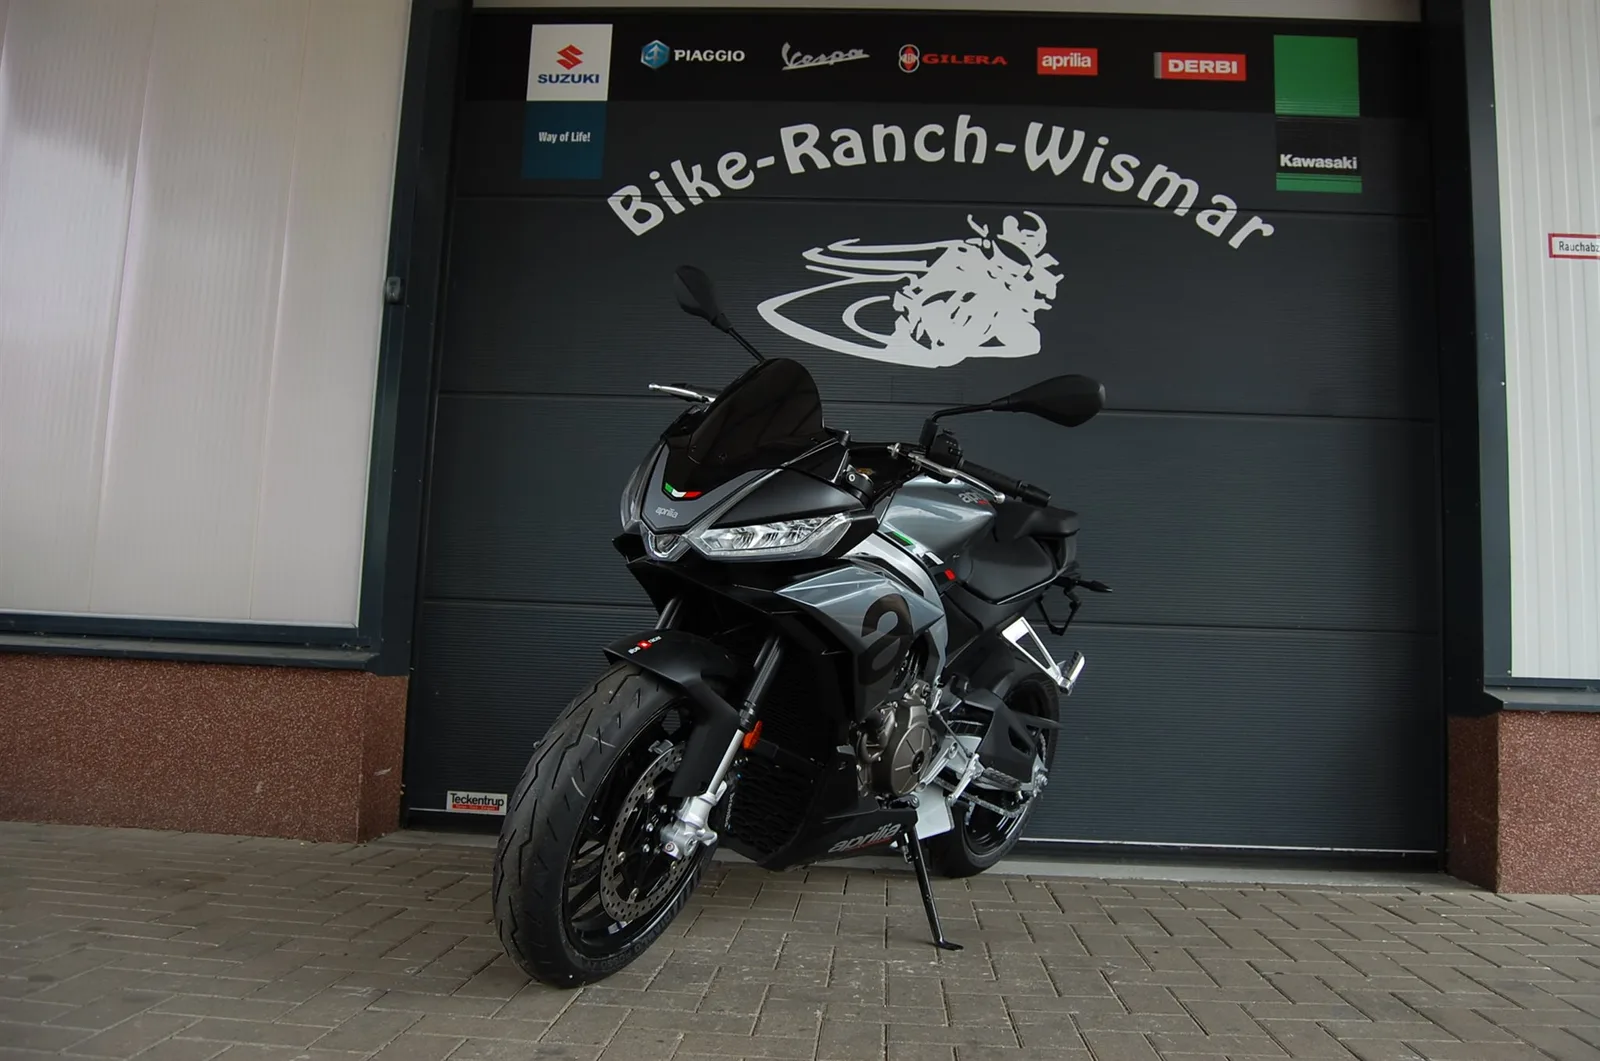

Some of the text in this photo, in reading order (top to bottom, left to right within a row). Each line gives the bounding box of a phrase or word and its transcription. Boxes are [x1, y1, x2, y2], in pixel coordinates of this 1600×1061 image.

[674, 49, 745, 62] PIAGGIO
[781, 41, 870, 71] Vespa
[922, 53, 1008, 66] GILERA
[1042, 53, 1092, 70] aprilia
[1168, 59, 1238, 74] DERBI
[537, 73, 600, 84] SUZUKI
[538, 131, 591, 144] Way of Life!
[1280, 153, 1358, 169] Kawasaki
[607, 114, 1274, 249] Bike-Ranch-Wismar
[449, 792, 505, 807] Teckentrup
[827, 822, 902, 853] aprilia
